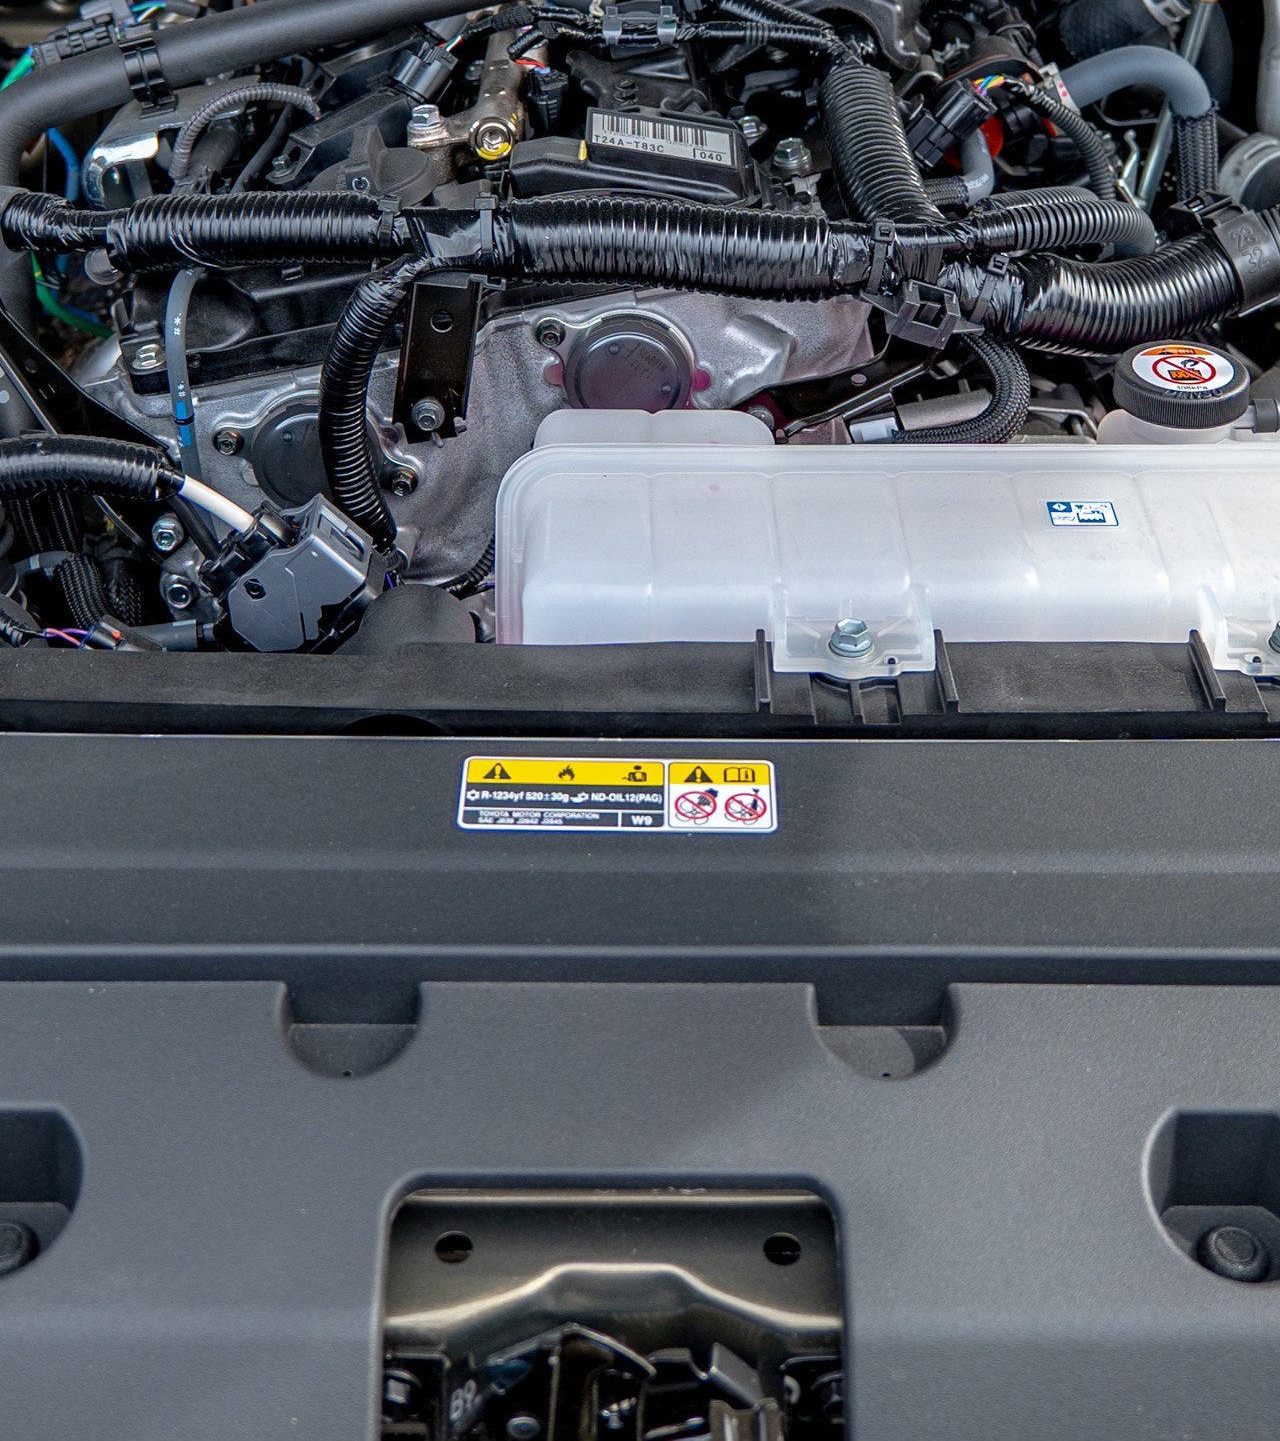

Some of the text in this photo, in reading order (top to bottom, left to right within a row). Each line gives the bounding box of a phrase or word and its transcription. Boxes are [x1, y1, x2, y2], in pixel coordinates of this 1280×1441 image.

[593, 134, 665, 153] T24A-T83C
[699, 151, 723, 162] 040
[480, 790, 523, 802] R-1234yf
[590, 791, 662, 804] ND-OIL12(PAG)
[478, 810, 510, 818] TOYOTA
[543, 812, 600, 820] CORPORATION
[630, 814, 653, 826] W9
